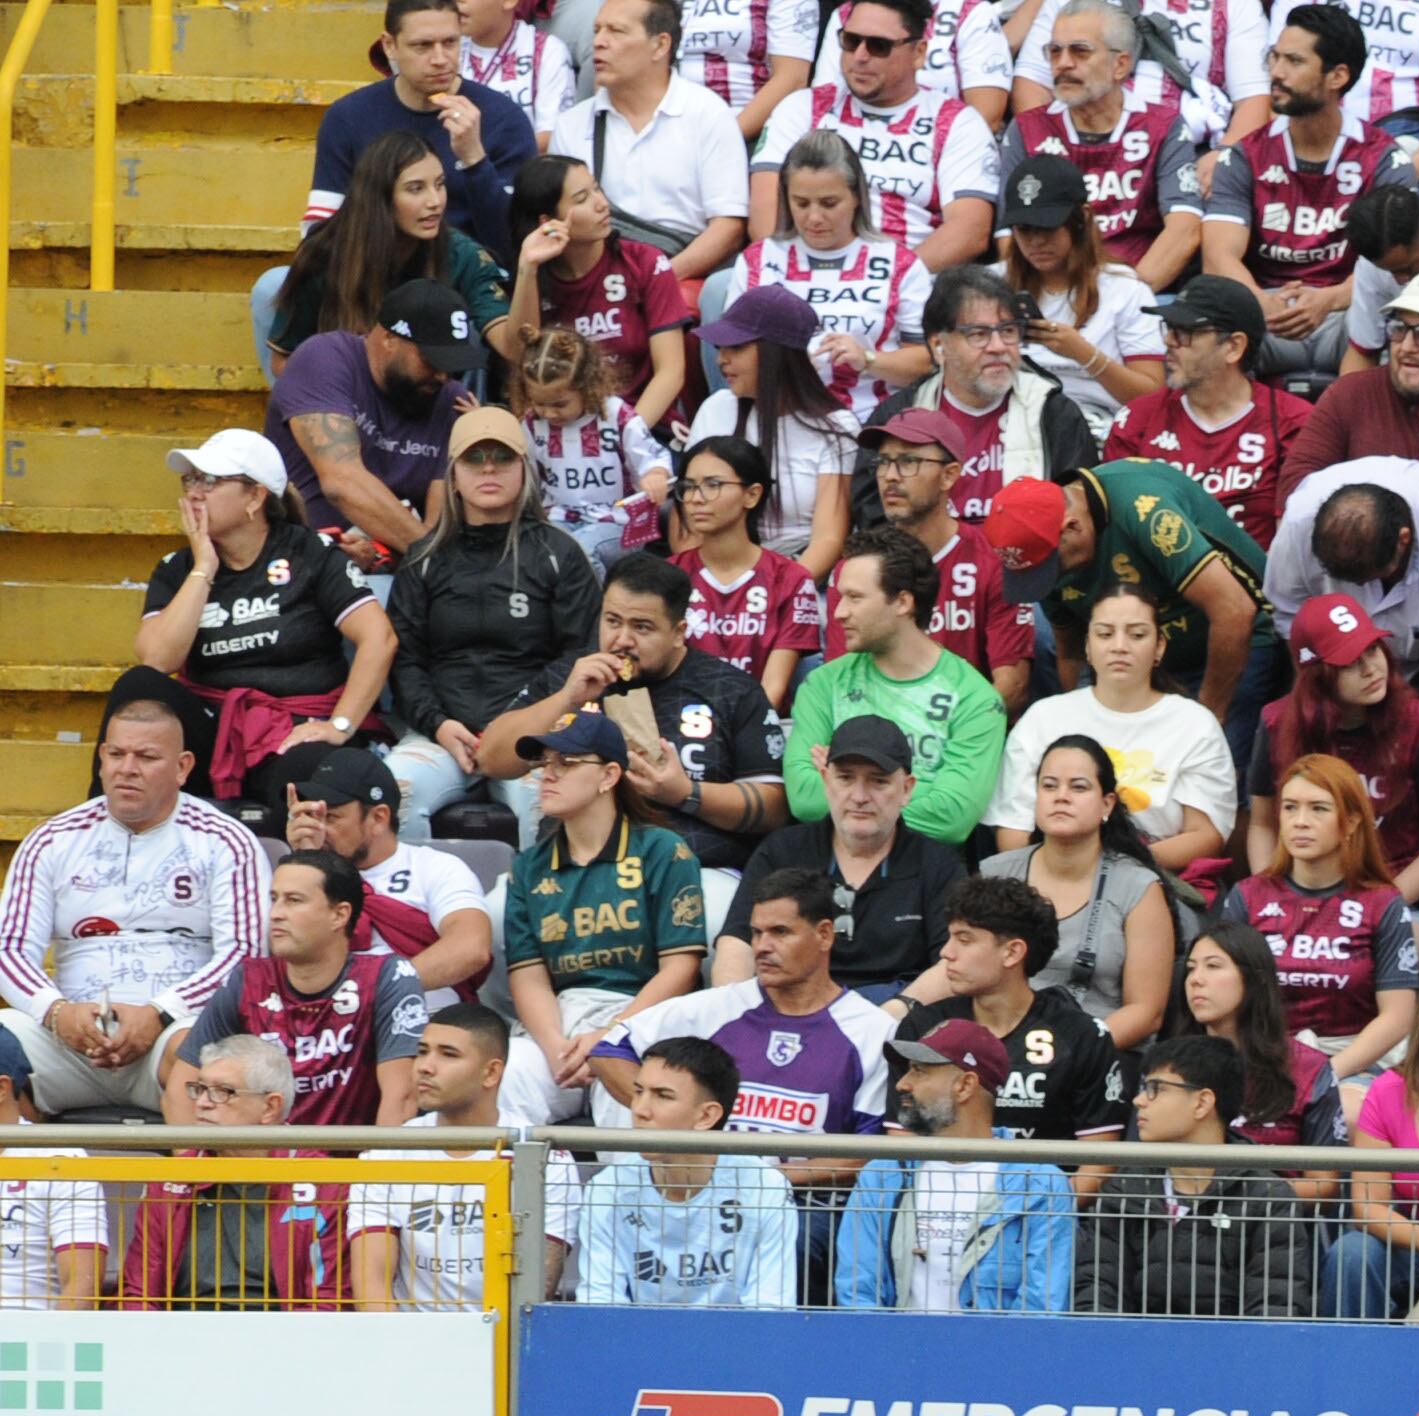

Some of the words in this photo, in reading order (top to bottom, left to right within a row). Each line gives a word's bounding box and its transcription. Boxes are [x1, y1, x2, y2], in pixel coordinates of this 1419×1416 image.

[936, 11, 957, 38] S
[1357, 4, 1416, 36] BAC
[913, 116, 934, 137] S
[857, 138, 928, 167] BAC
[1123, 130, 1151, 161] S
[1336, 162, 1363, 196] S
[1293, 205, 1348, 237] BAC
[1259, 240, 1349, 264] LIBERTY
[868, 256, 890, 281] S
[604, 273, 627, 303] S
[806, 285, 883, 303] BAC
[450, 311, 470, 340] S
[574, 308, 622, 336] BAC
[599, 429, 621, 453] S
[1237, 433, 1266, 464] S
[566, 464, 617, 491] BAC
[268, 558, 291, 586] S
[952, 563, 977, 597] S
[1111, 553, 1141, 584] S
[232, 595, 280, 618] BAC
[509, 593, 529, 618] S
[746, 586, 768, 614] S
[707, 611, 767, 638] kölbi
[1329, 605, 1358, 634] S
[201, 630, 280, 656] LIBERTY
[679, 704, 713, 738] S
[925, 692, 953, 722] S
[173, 875, 193, 900] S
[388, 870, 412, 894] S
[616, 857, 643, 890] S
[573, 899, 641, 938] BAC
[1339, 899, 1363, 928] S
[548, 944, 644, 978] LIBERTY
[1291, 935, 1351, 962] BAC
[1278, 971, 1349, 990] BERTY
[332, 979, 359, 1015] S
[295, 1023, 354, 1063] BAC
[1025, 1030, 1055, 1065] S
[997, 1072, 1047, 1102] AC
[733, 1093, 817, 1128] BIMBO
[719, 1199, 743, 1234] S
[416, 1254, 485, 1276] LIBERT
[679, 1249, 735, 1279] BAC
